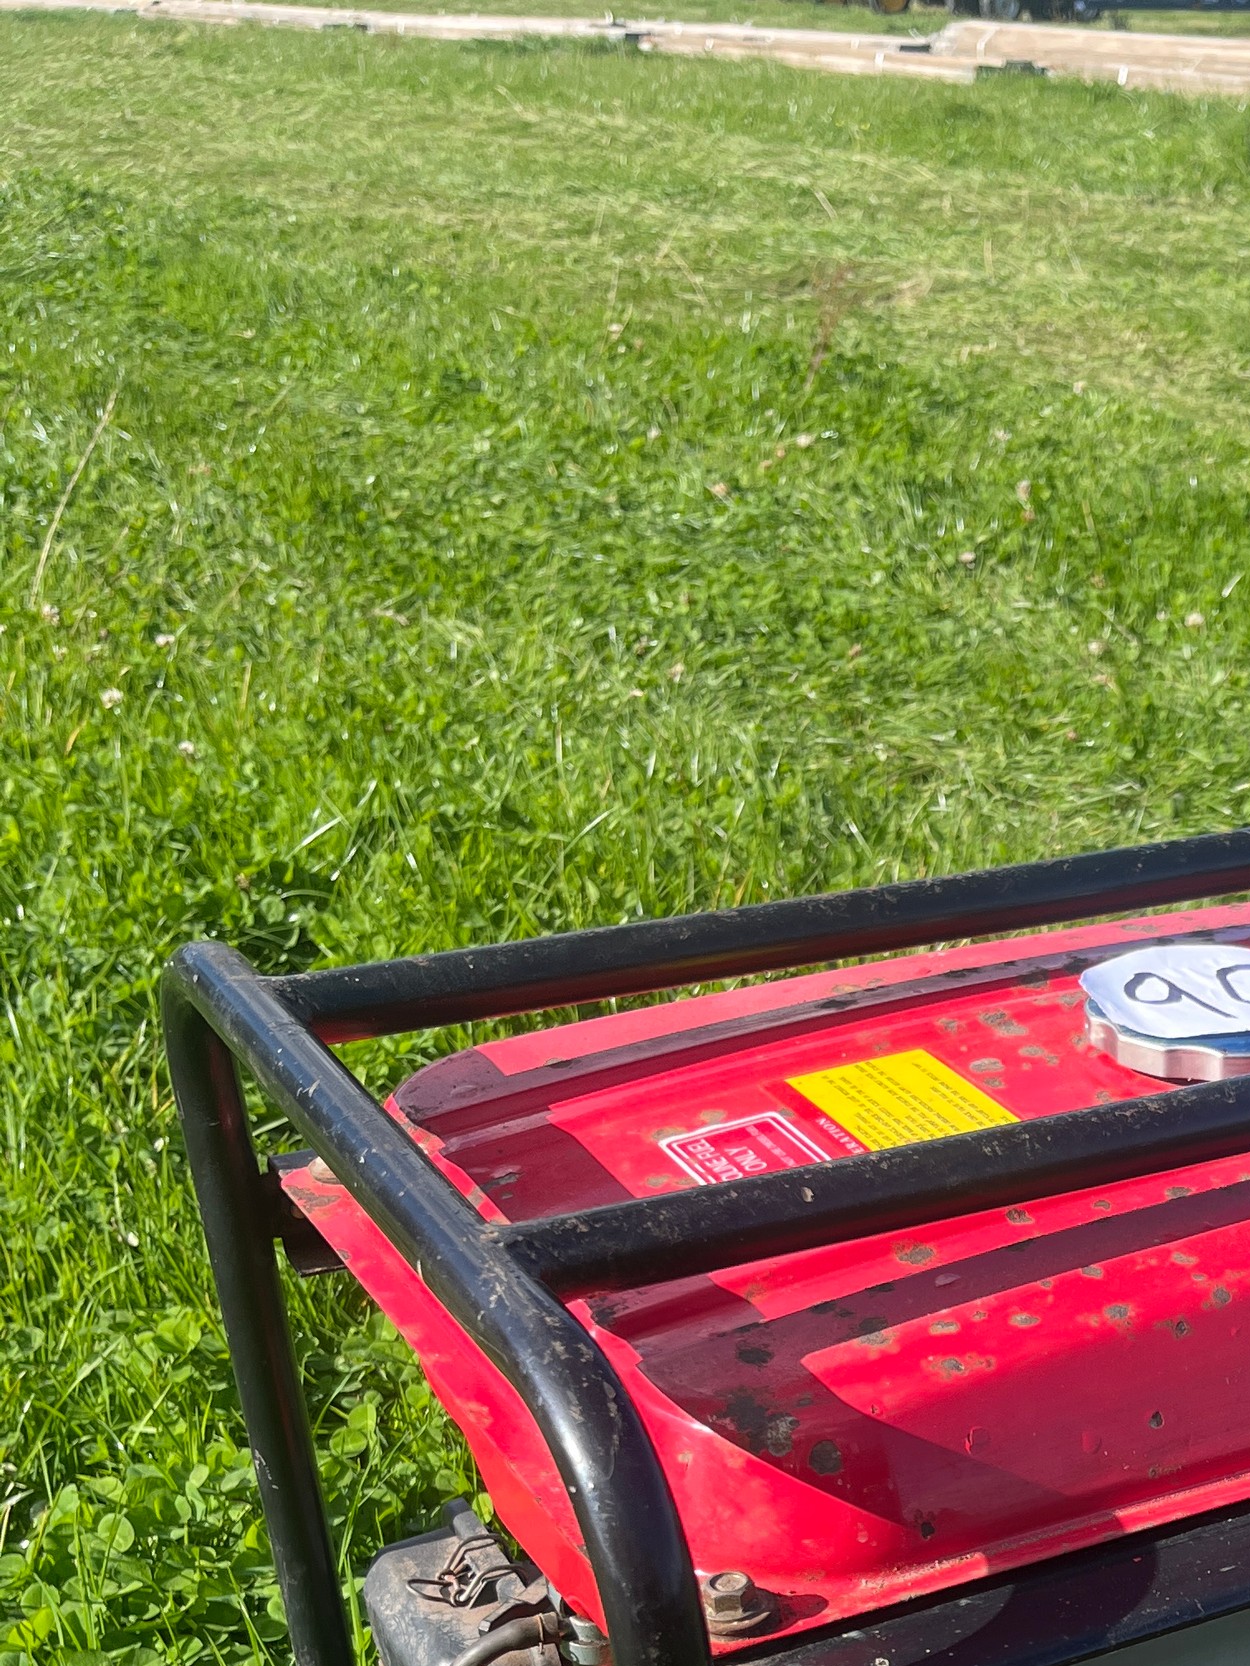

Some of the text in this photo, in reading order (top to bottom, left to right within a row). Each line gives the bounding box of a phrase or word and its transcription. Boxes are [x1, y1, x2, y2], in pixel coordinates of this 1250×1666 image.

[815, 1116, 866, 1155] ERATION
[704, 1156, 745, 1182] OLINE
[723, 1145, 769, 1172] ONLY
